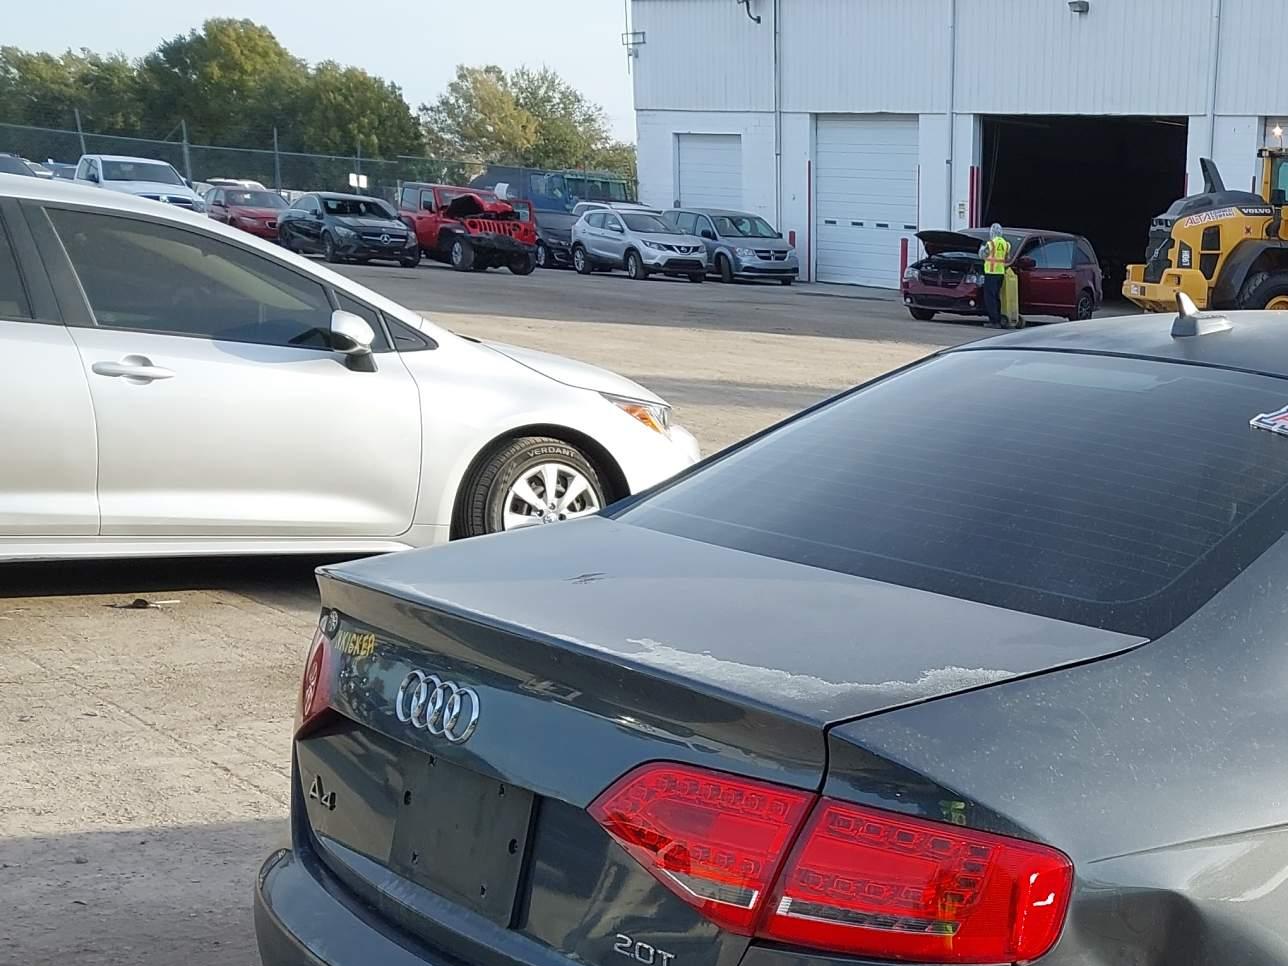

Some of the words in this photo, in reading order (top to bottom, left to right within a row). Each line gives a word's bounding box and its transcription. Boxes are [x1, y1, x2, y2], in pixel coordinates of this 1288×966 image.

[1184, 212, 1212, 227] ALTA
[527, 446, 577, 458] VERDANT
[310, 775, 336, 811] A4
